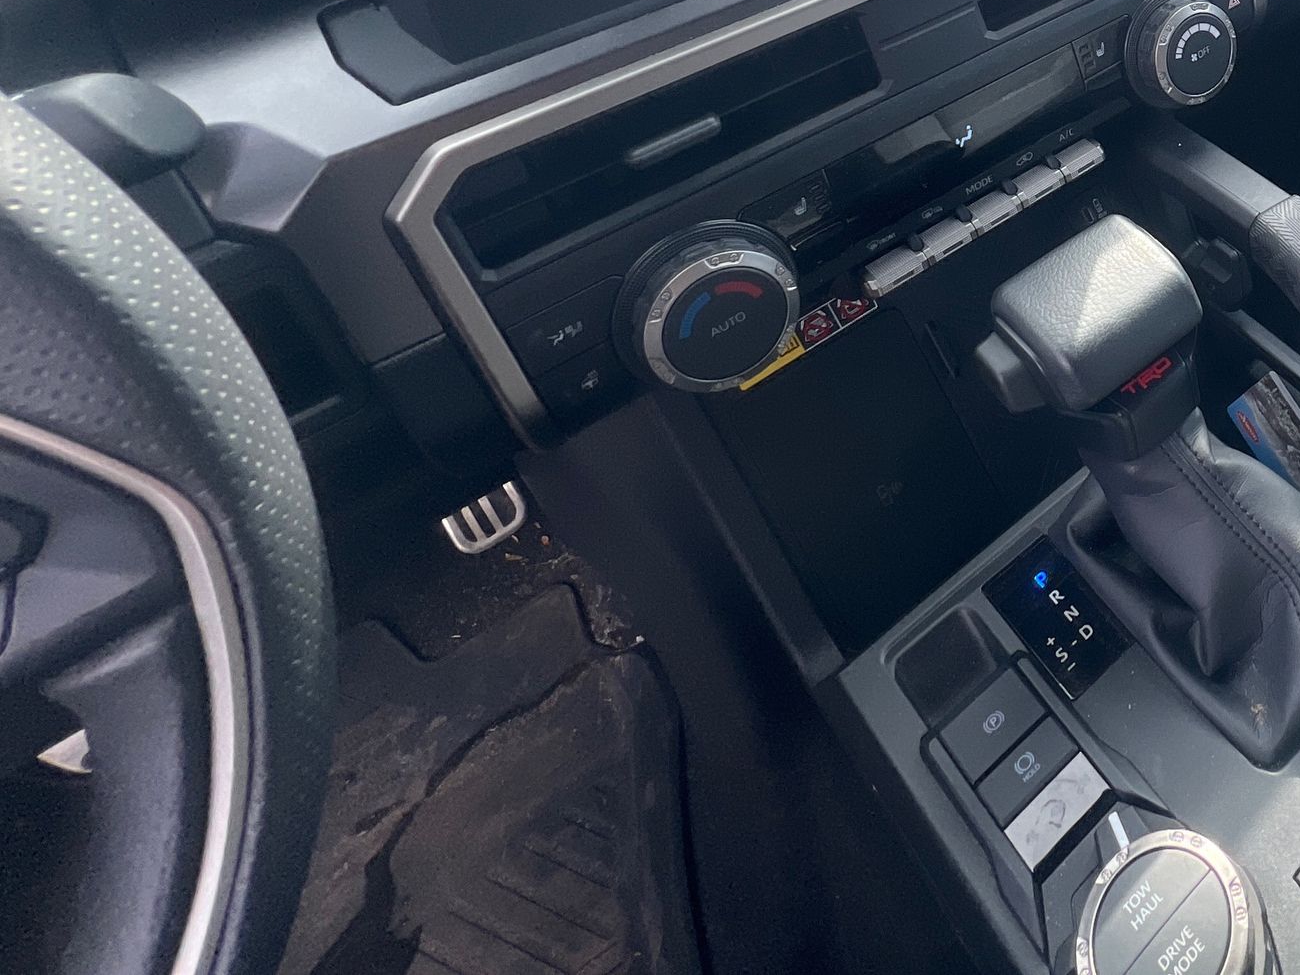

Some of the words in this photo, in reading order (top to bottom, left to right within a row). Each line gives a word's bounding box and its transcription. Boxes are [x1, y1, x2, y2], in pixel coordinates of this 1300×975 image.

[1197, 45, 1211, 59] OFF
[1059, 128, 1074, 142] A/C
[965, 174, 993, 195] MODE
[711, 311, 746, 338] AUTO
[1120, 356, 1173, 394] TRD
[1034, 571, 1047, 589] P
[1048, 589, 1065, 605] R
[1063, 605, 1080, 622] N
[1078, 624, 1094, 641] D
[1055, 647, 1069, 663] S
[1022, 763, 1041, 783] HOLD
[1122, 880, 1151, 914] TOW
[1130, 893, 1164, 931] HAUL
[1157, 925, 1194, 972] DRIVE
[1167, 937, 1206, 975] MODE
